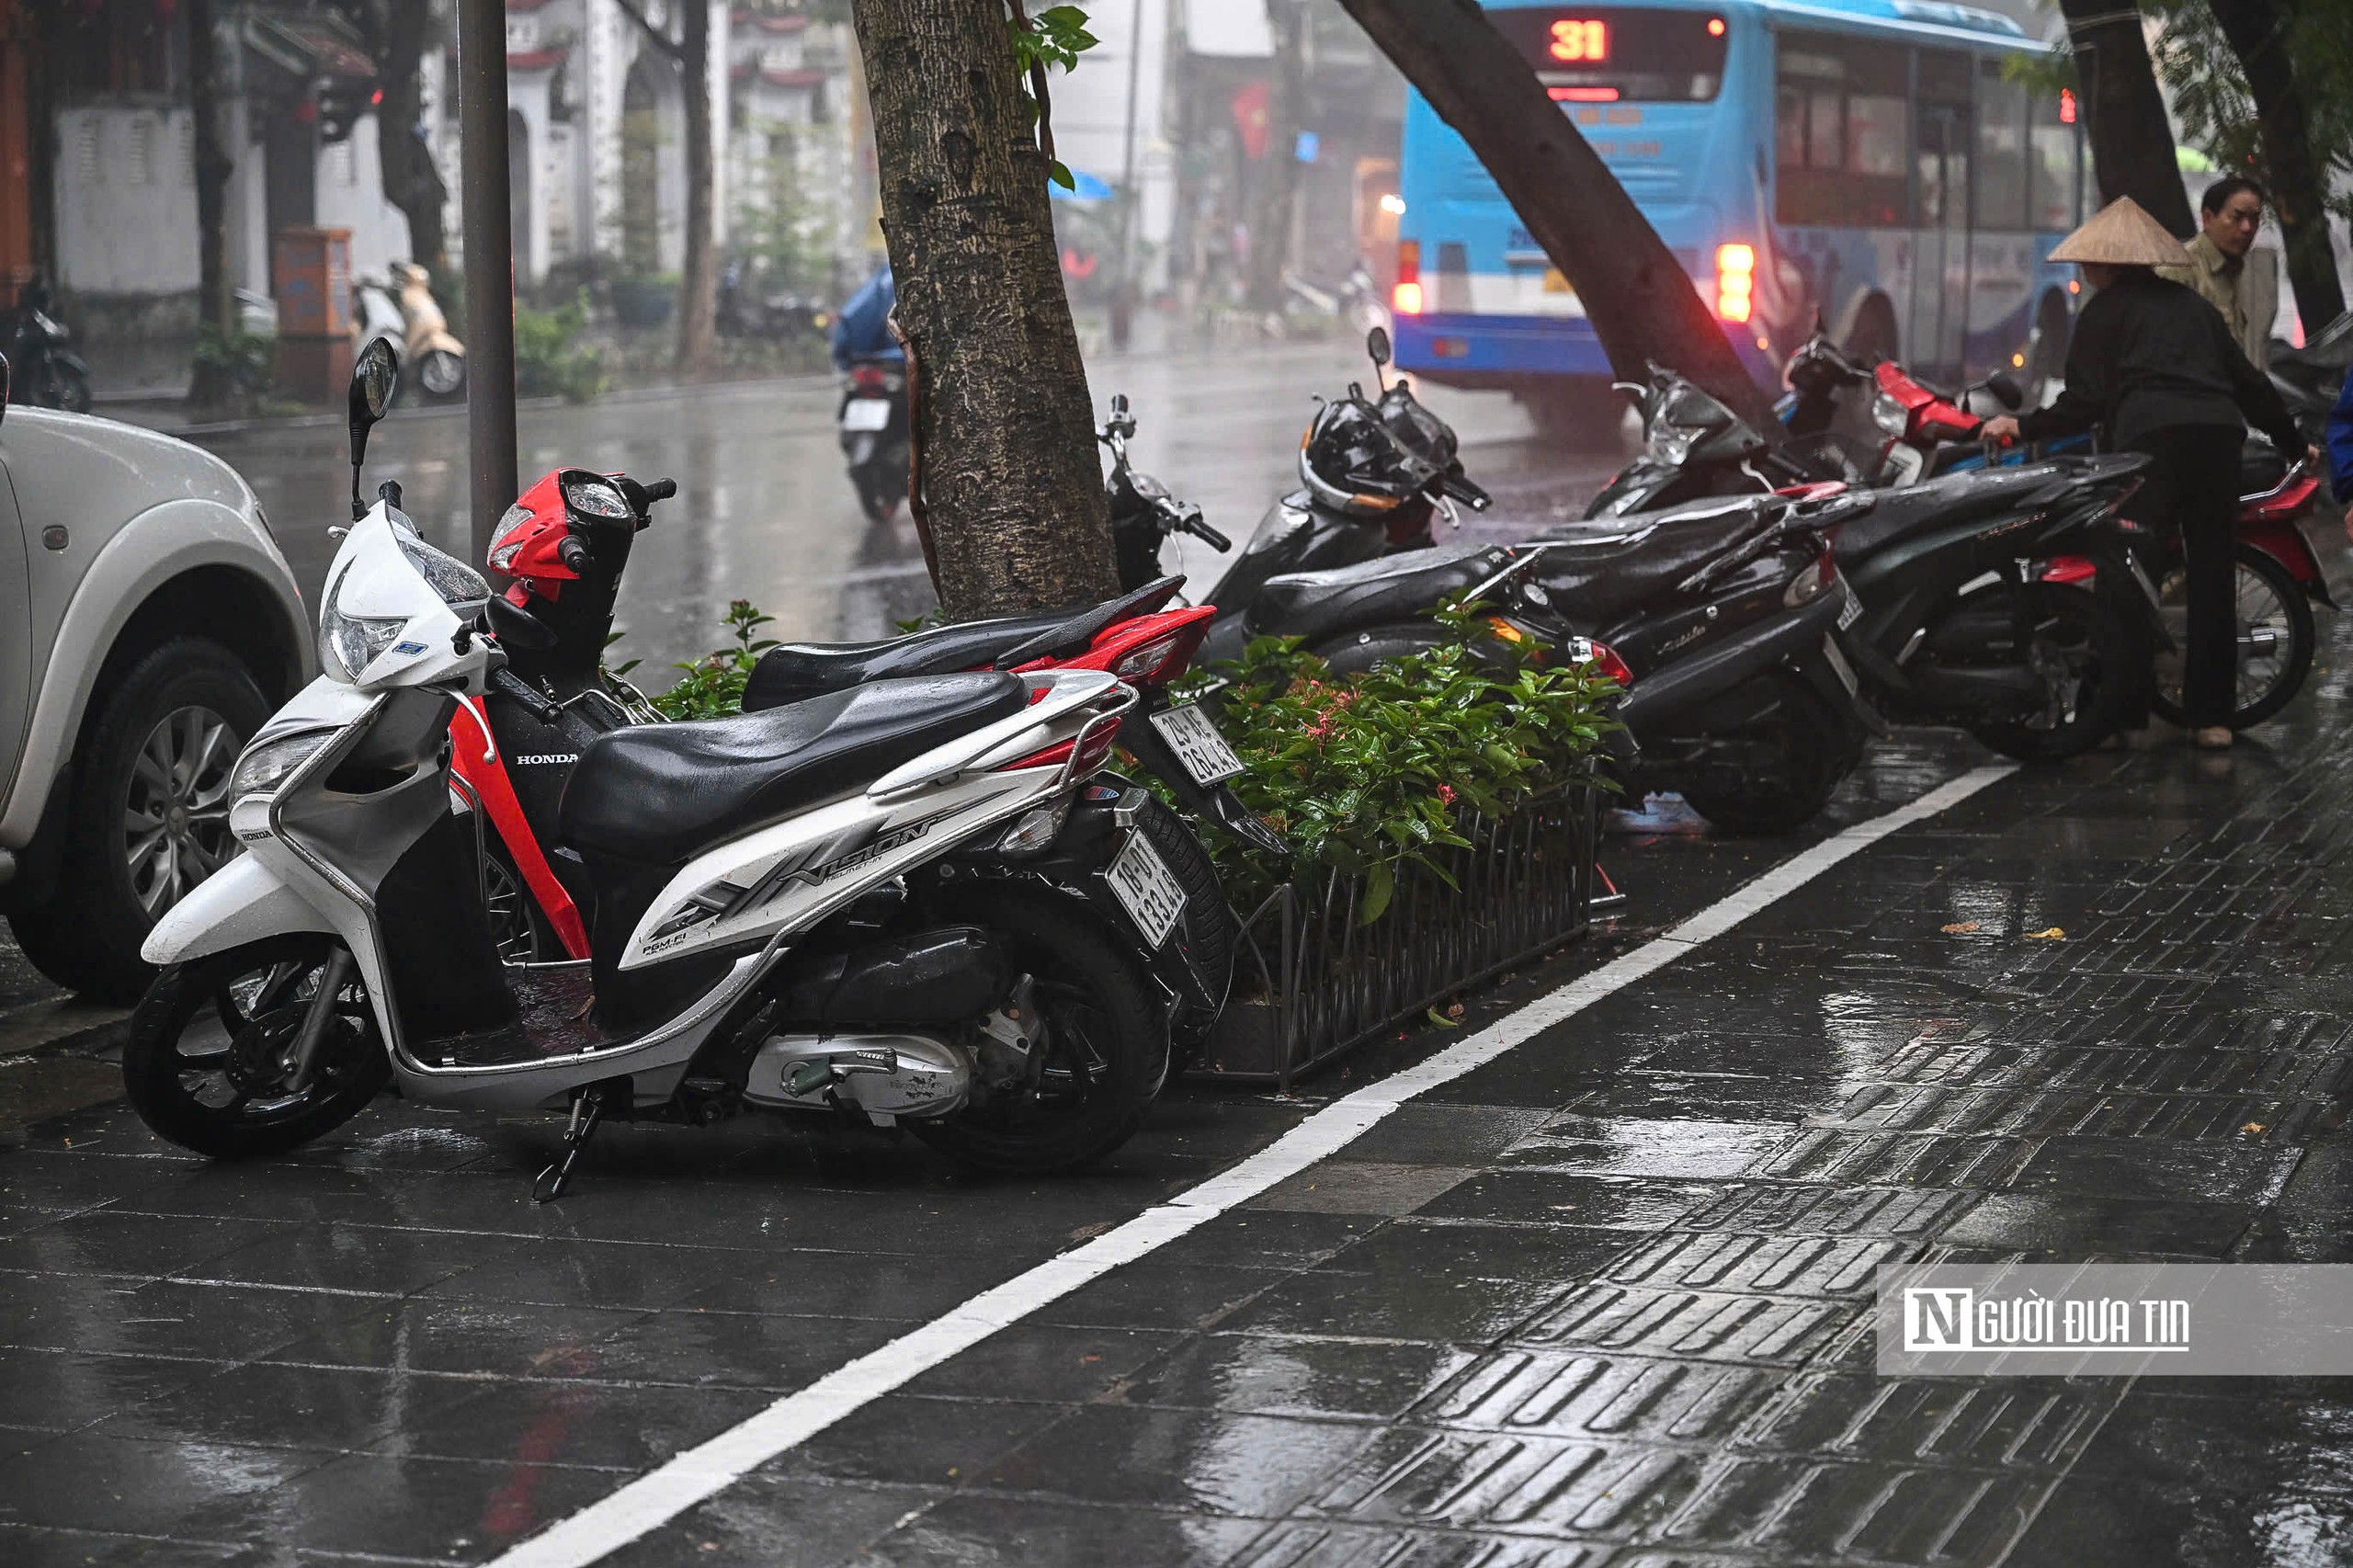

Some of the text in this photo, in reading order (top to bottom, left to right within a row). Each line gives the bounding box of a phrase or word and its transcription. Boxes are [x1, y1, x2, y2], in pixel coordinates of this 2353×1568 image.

[1551, 20, 1605, 61] 31
[517, 754, 578, 765] HONDA
[241, 830, 274, 841] HONDA
[777, 816, 938, 887] VISION
[825, 856, 882, 883] HELMET-IN
[1137, 869, 1183, 938] 133.48
